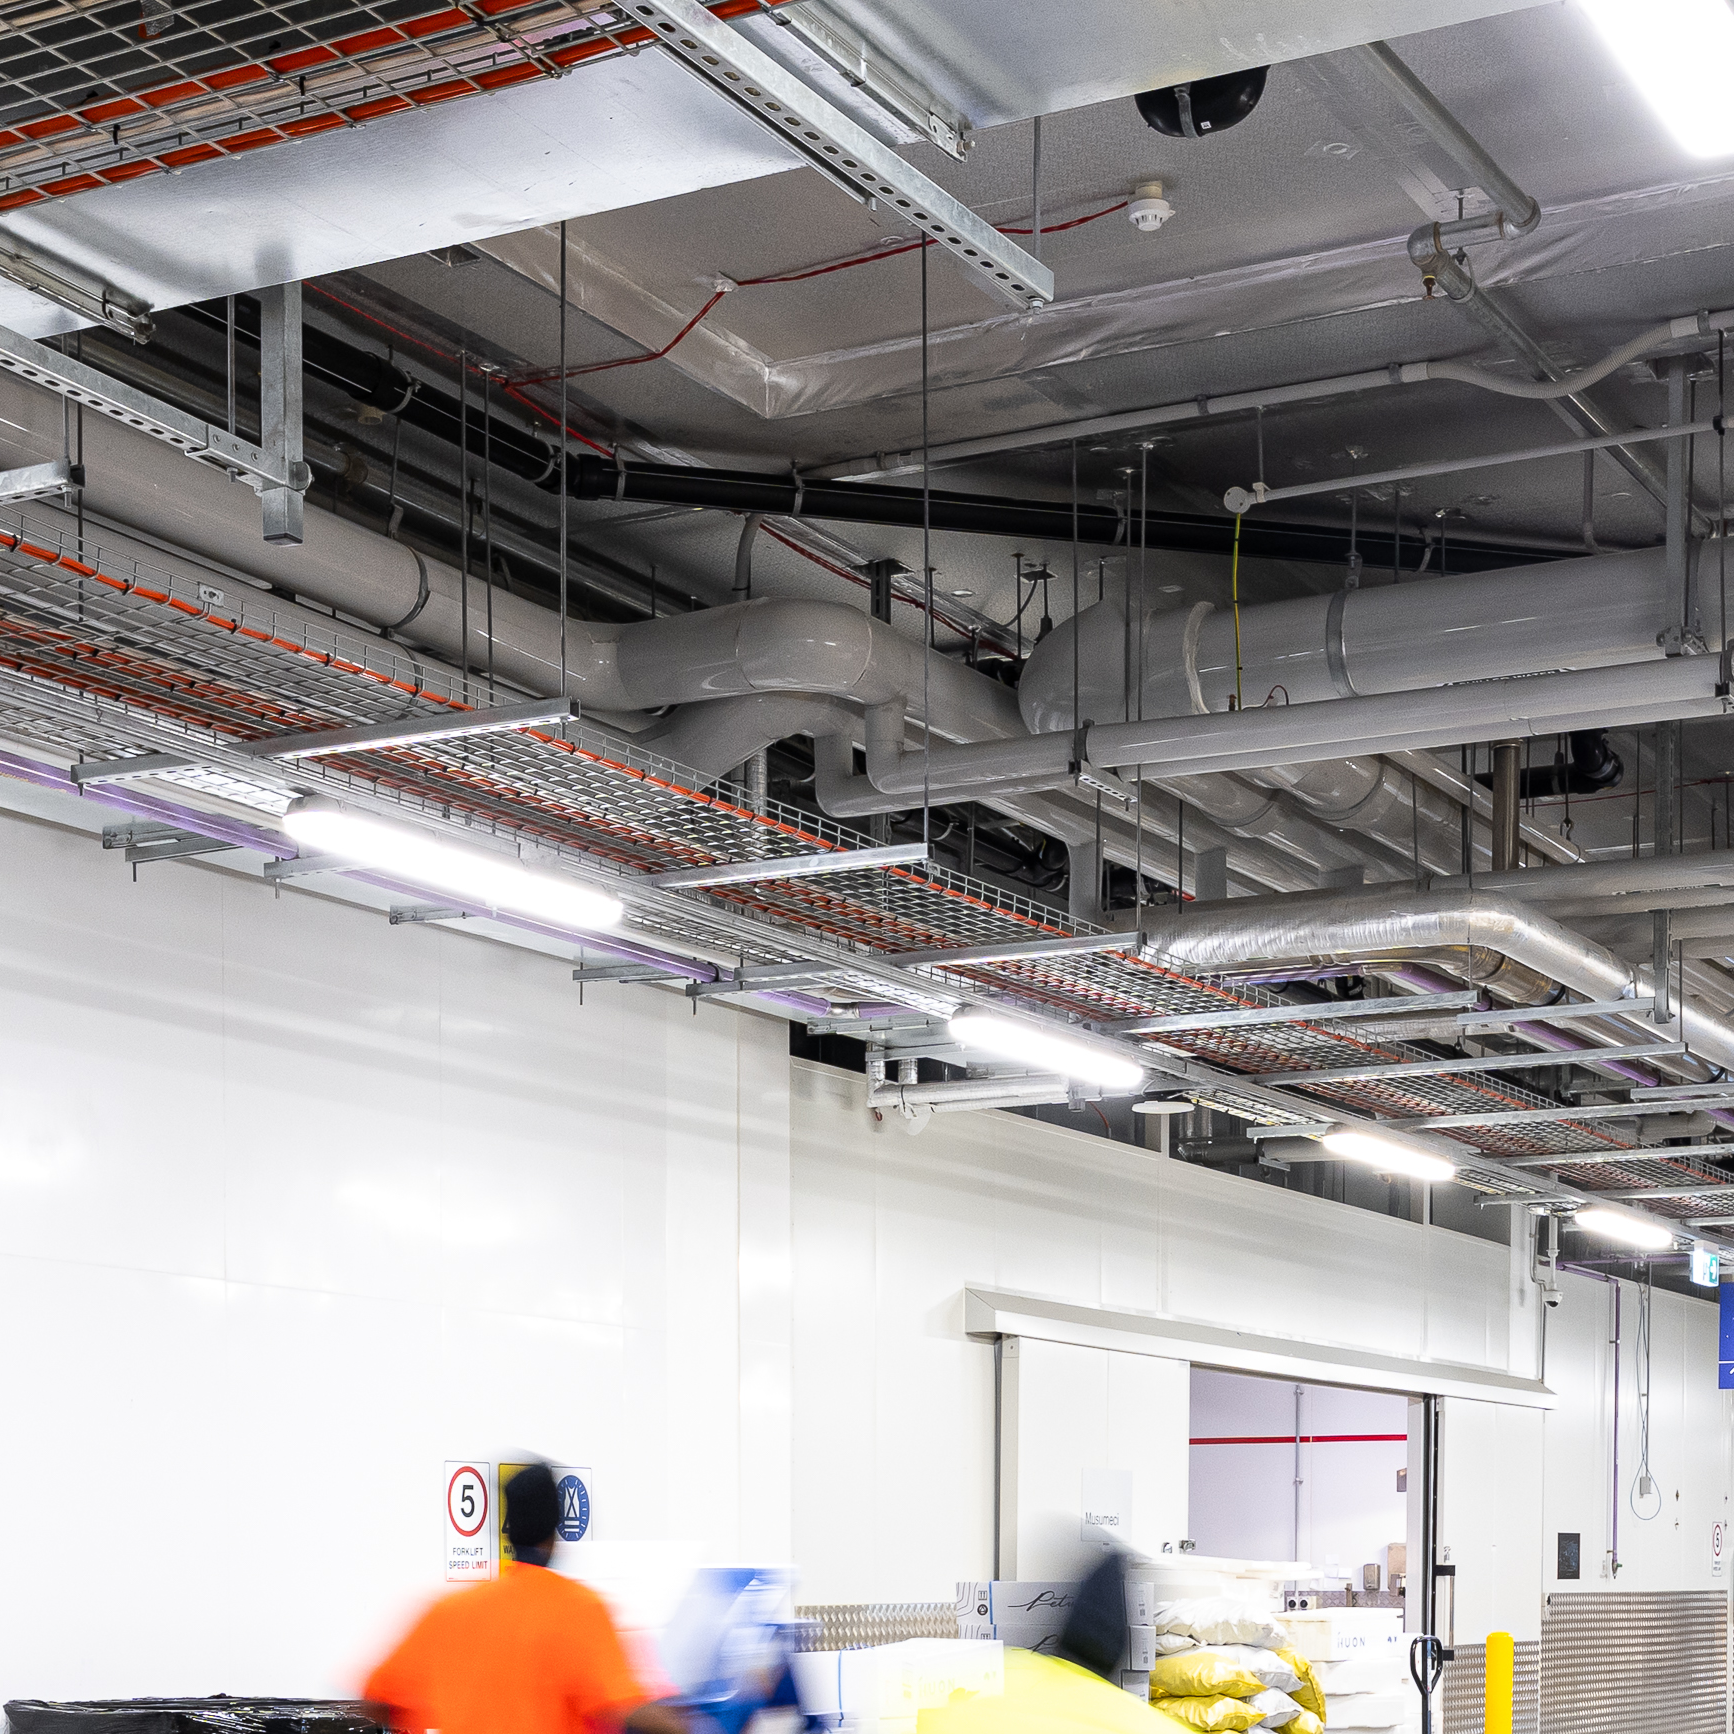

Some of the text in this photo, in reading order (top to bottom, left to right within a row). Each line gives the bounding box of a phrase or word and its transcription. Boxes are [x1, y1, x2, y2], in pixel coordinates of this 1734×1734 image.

[461, 1485, 475, 1518] 5
[453, 1548, 483, 1556] FORKLIFT
[449, 1561, 488, 1569] SPEED LIMIT
[1338, 1632, 1365, 1648] HUON
